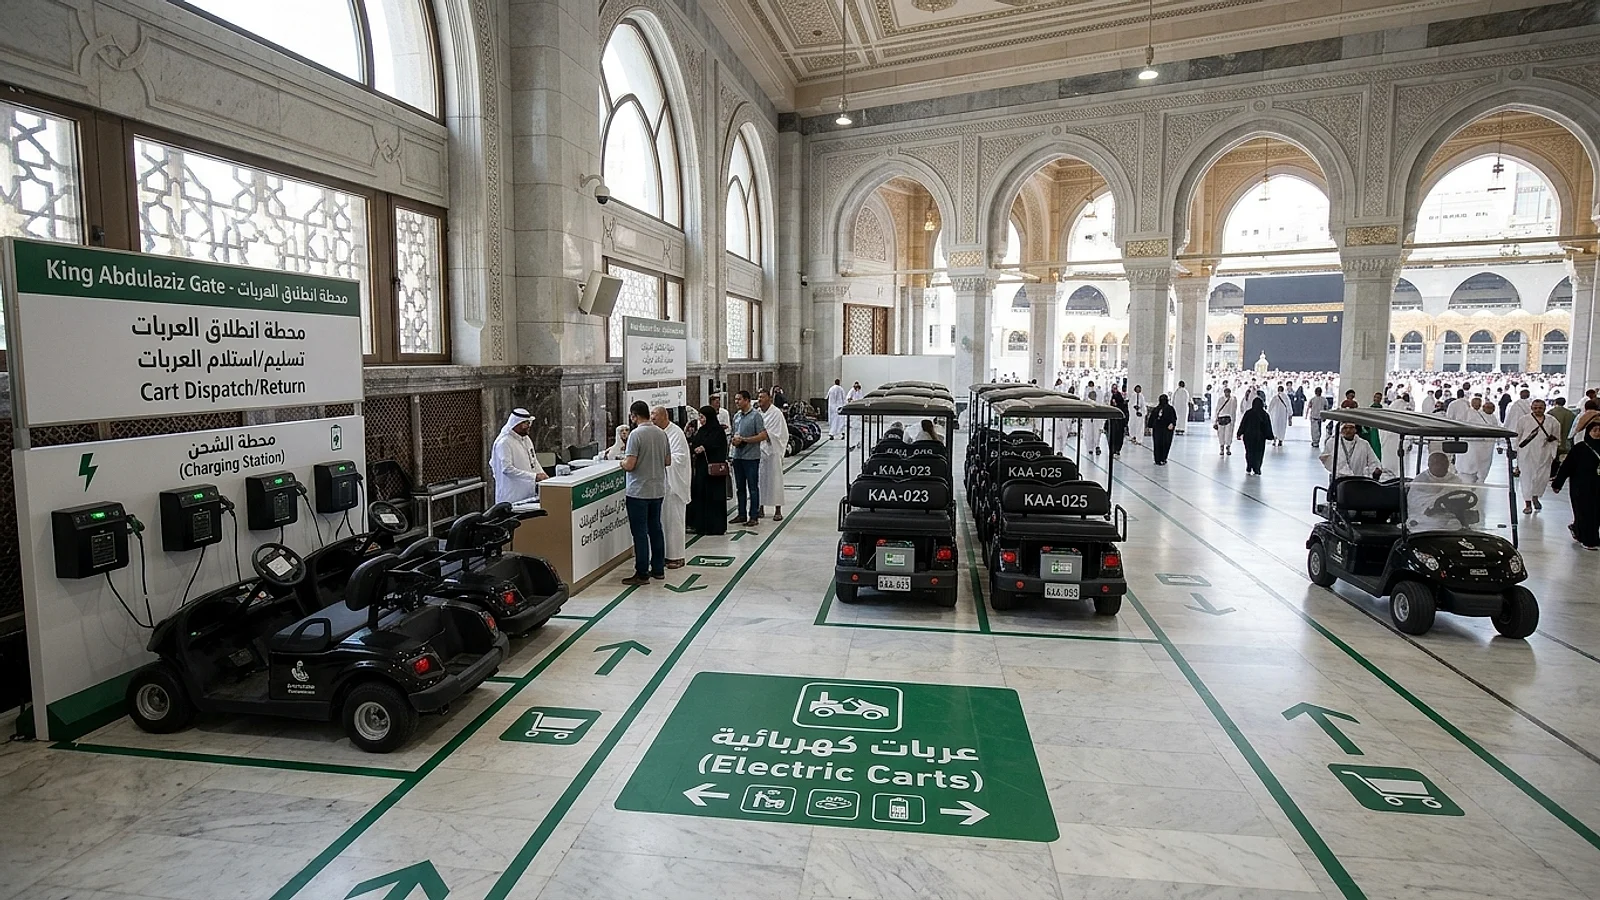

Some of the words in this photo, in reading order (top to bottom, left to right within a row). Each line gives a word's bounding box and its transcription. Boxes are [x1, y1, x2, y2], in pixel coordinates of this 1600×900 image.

[46, 259, 93, 288] King
[98, 265, 186, 291] Abdulaziz
[189, 275, 226, 294] Gate
[319, 288, 348, 304] محطة
[131, 315, 199, 341] العربات
[205, 319, 259, 343] انطلاق
[263, 321, 306, 340] محطة
[138, 348, 202, 372] العربات
[207, 349, 305, 373] تسليم/استلام
[140, 382, 180, 401] Cart
[185, 378, 306, 402] Dispatch/Return
[188, 434, 234, 460] الشحن
[237, 433, 276, 448] محطة
[179, 458, 240, 480] (Charging
[242, 450, 285, 468] Station)
[879, 465, 931, 476] KAA-023
[868, 488, 929, 502] KAA-023
[1024, 493, 1088, 508] KAA-025
[711, 727, 858, 757] كهربائية
[870, 739, 979, 764] عربات
[698, 753, 855, 782] (Electric
[867, 765, 984, 793] Carts)
